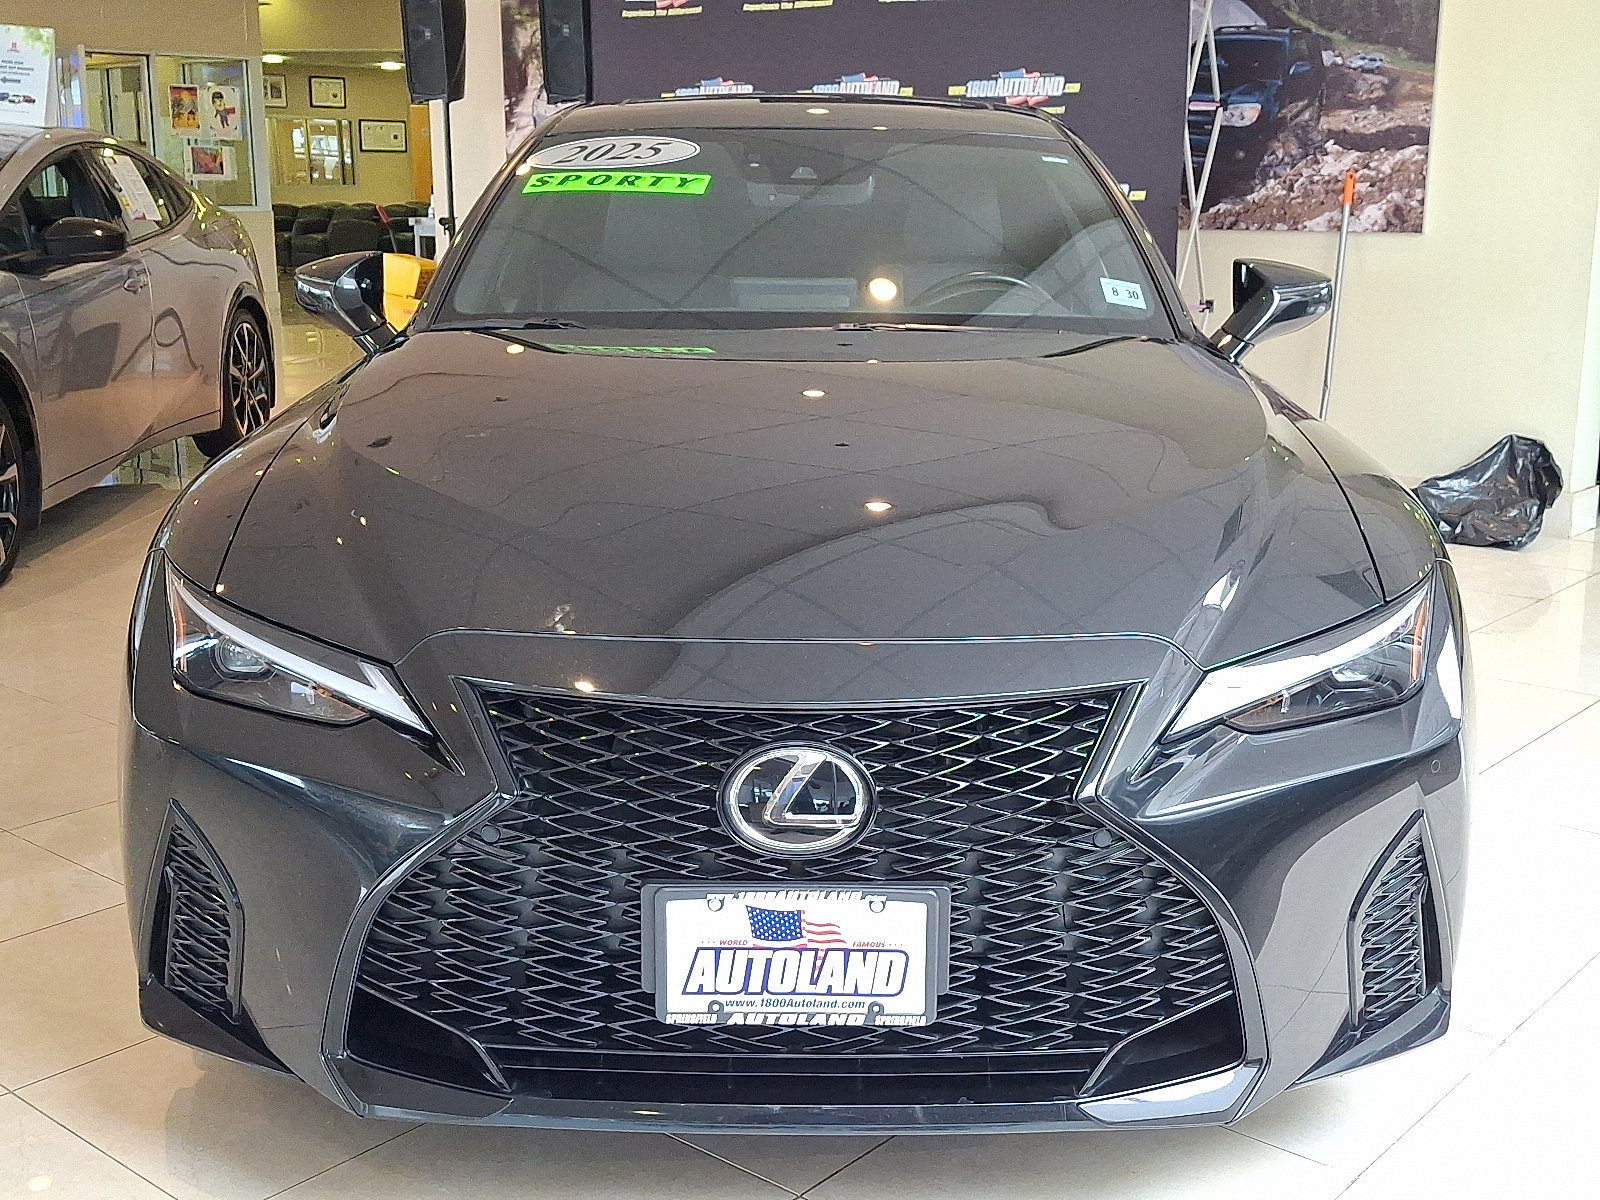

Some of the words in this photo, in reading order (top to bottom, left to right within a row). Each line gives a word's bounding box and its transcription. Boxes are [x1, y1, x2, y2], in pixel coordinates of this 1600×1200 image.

[966, 76, 1065, 97] 1800AUTOLAND
[552, 142, 672, 164] 2025
[530, 174, 704, 188] SPORTY
[1111, 286, 1119, 296] 8
[1125, 289, 1139, 300] 30
[681, 947, 910, 997] AUTOLAND
[725, 998, 866, 1010] www.1800Autoland.com
[726, 1012, 866, 1026] AUTOLAND
